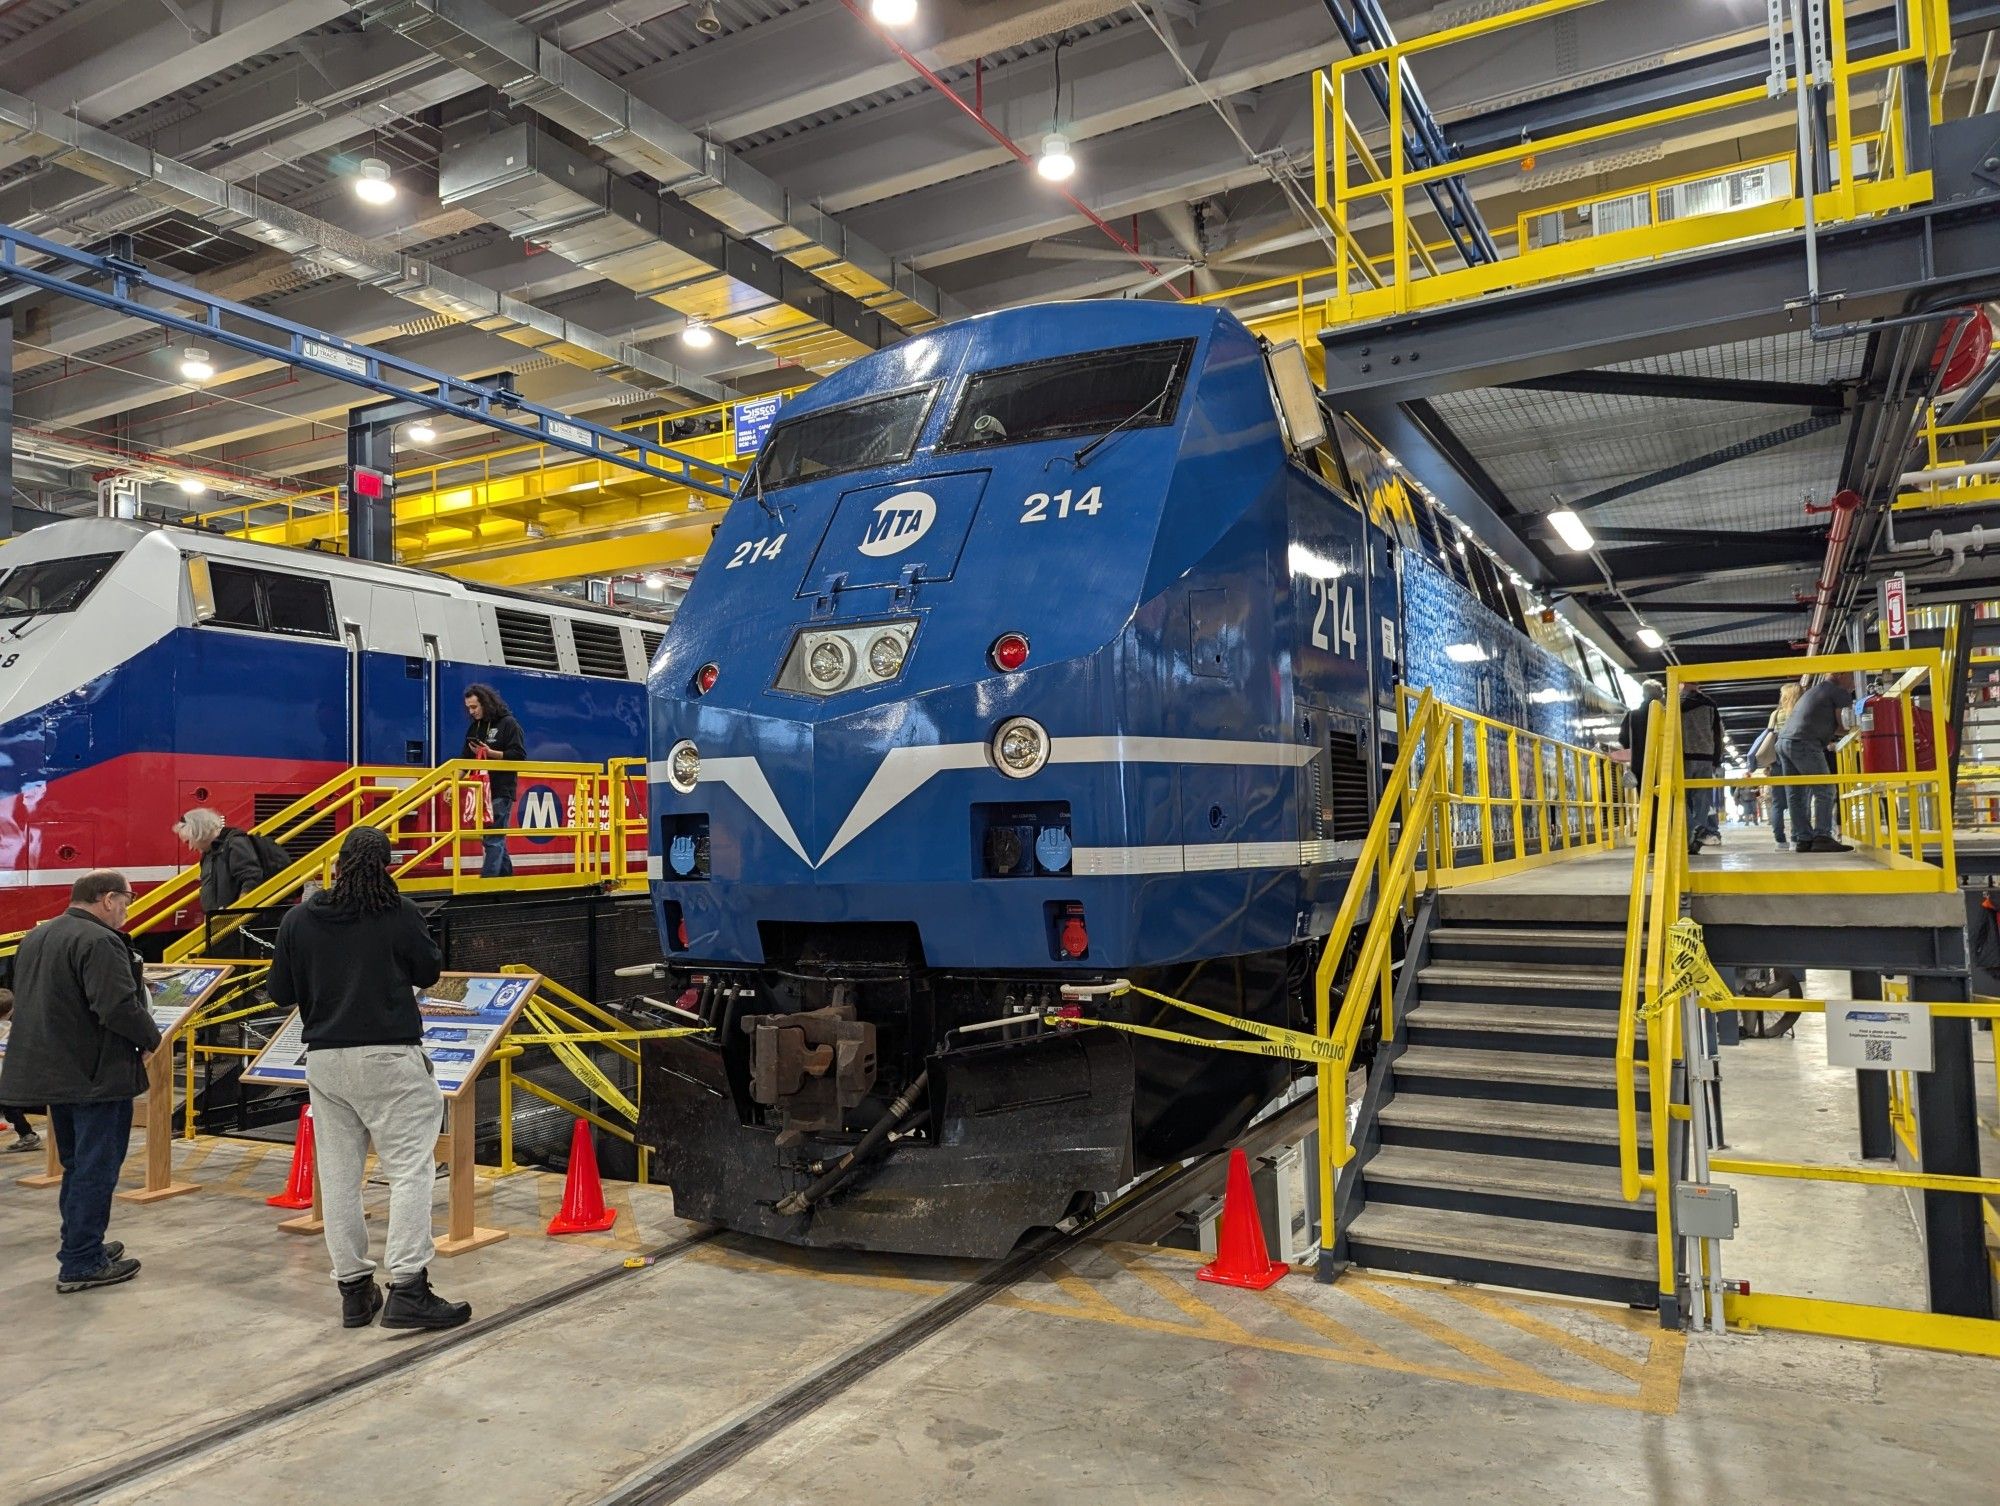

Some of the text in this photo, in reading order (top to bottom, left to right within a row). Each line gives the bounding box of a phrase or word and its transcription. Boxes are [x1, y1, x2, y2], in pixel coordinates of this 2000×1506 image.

[1019, 486, 1103, 524] 214
[860, 508, 923, 546] MTA
[725, 532, 788, 570] 214
[1887, 582, 1902, 591] FIRE
[1310, 577, 1358, 660] 214
[0, 653, 20, 668] 8
[521, 791, 560, 830] M
[174, 910, 188, 926] F
[1295, 911, 1304, 936] F
[1311, 1039, 1345, 1061] CAUTIO
